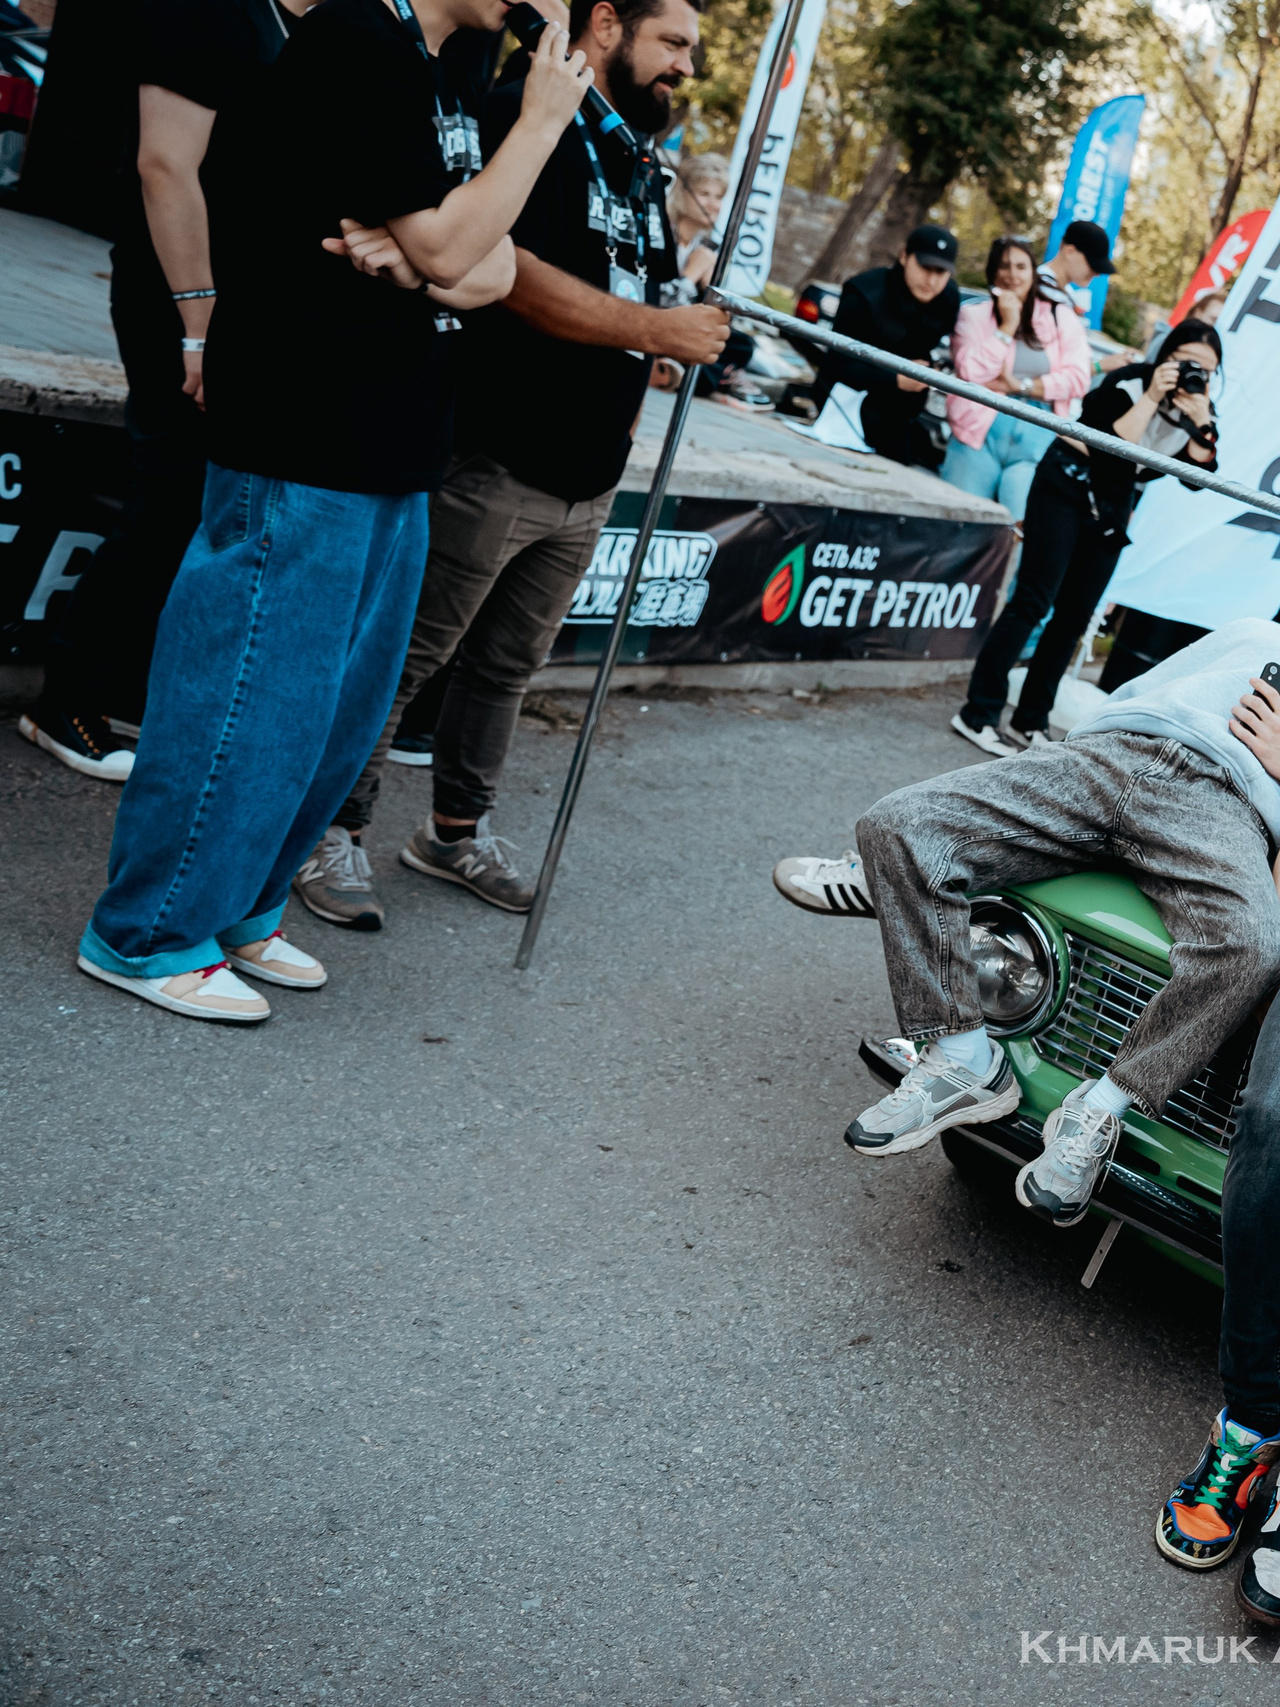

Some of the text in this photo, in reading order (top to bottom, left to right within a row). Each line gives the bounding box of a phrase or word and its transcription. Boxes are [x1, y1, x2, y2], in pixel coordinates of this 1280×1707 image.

[1072, 130, 1109, 222] OREST
[585, 533, 711, 578] ARKING
[812, 542, 849, 570] СЕТЬ
[800, 575, 982, 629] GET PETROL
